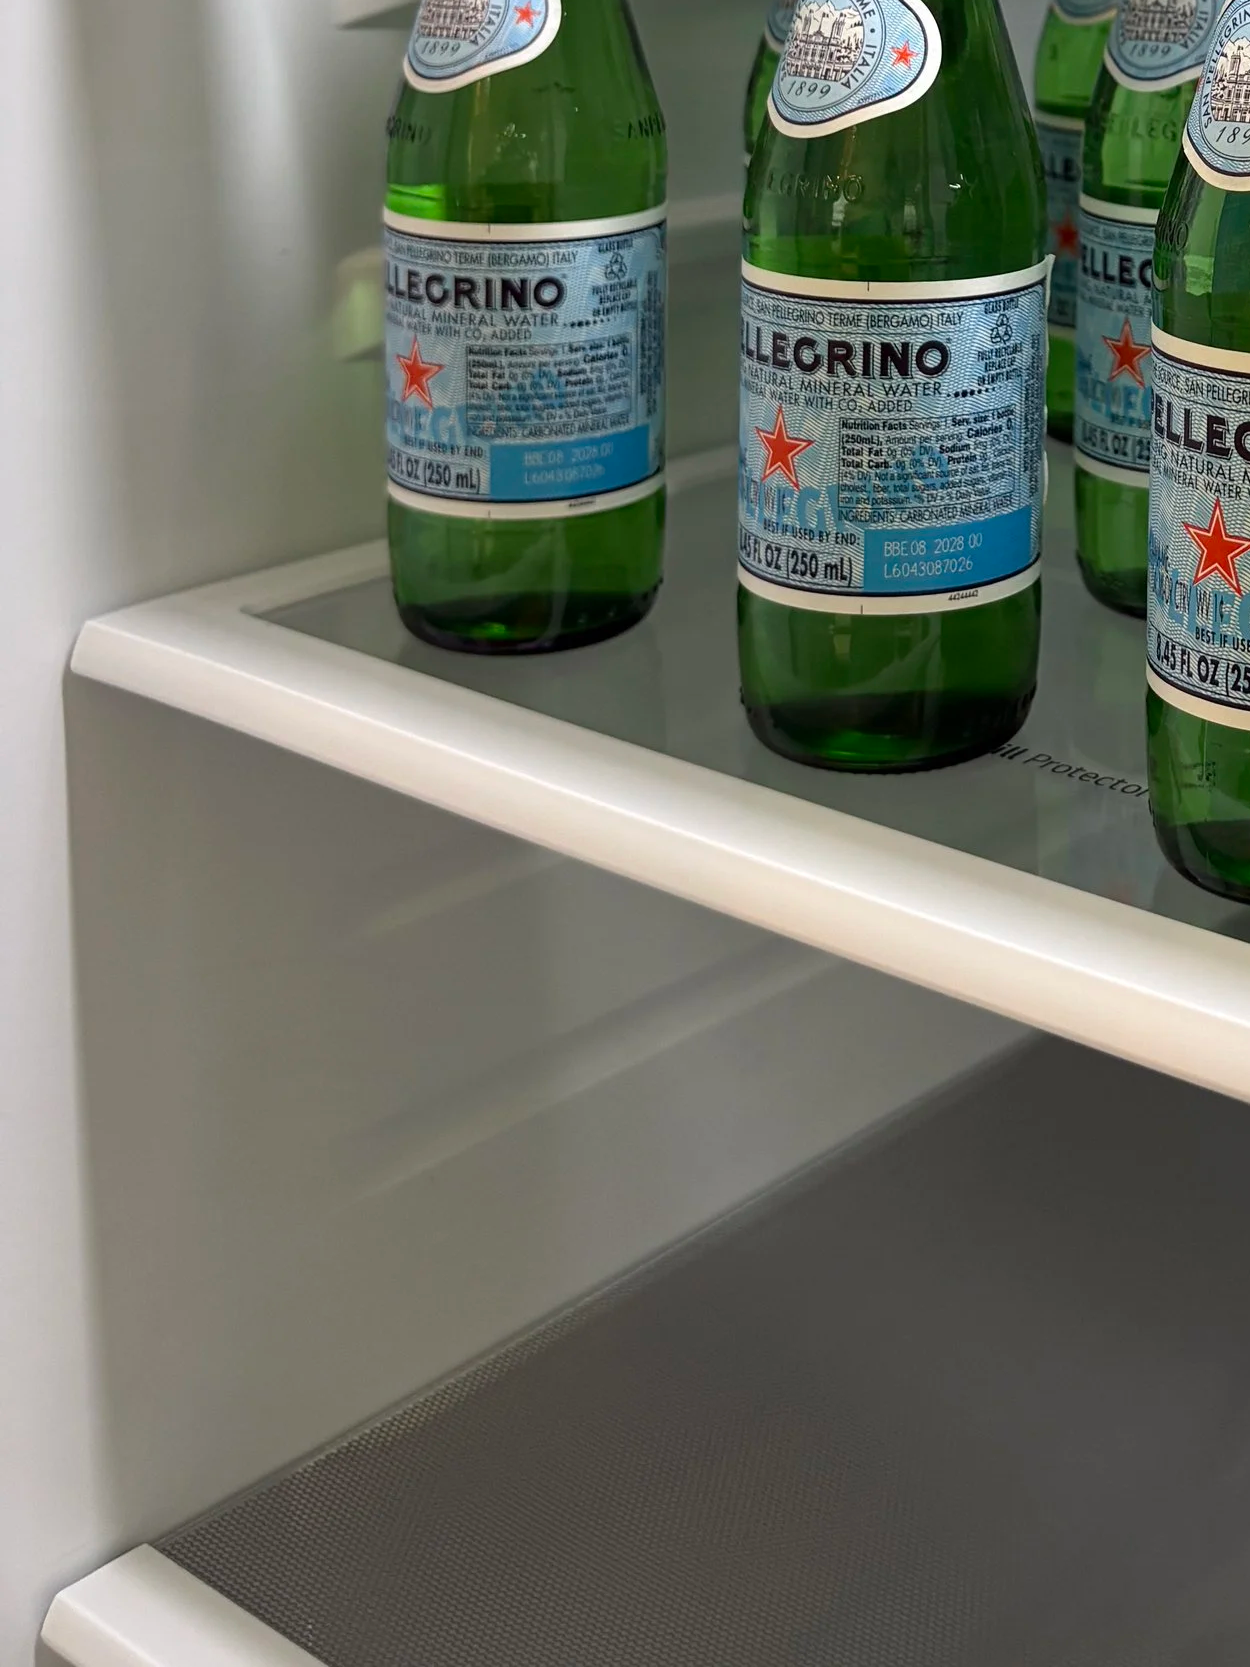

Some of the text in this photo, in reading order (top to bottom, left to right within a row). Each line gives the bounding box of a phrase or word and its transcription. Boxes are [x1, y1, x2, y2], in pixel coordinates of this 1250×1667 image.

[469, 6, 503, 47] ITALIA
[421, 40, 462, 56] 1899
[840, 44, 878, 90] ITALIA
[786, 81, 832, 99] 1899
[1201, 94, 1211, 129] SAN
[454, 250, 578, 268] TERME (BERGAMO) ITALY
[432, 311, 559, 327] MINERAL WATER
[827, 311, 862, 327] TERME
[865, 313, 934, 330] (BERGAMO)
[936, 310, 964, 326] ITALY
[491, 327, 532, 340] ADDED
[800, 380, 874, 397] MINERAL
[883, 383, 942, 396] WATER
[1185, 378, 1203, 395] SAN
[803, 393, 834, 409] WITH
[868, 399, 913, 412] ADDED
[1172, 449, 1235, 481] NATURAL
[406, 457, 480, 495] OZ (250 mL)
[1202, 478, 1242, 500] WATER
[793, 525, 816, 542] USED
[834, 530, 860, 546] END:
[934, 536, 965, 553] 2028
[968, 533, 983, 548] 00
[764, 544, 853, 587] OZ (250 mL)
[1195, 626, 1216, 644] BEST
[1220, 634, 1228, 647] IF
[1180, 649, 1193, 677] FL
[1197, 655, 1220, 686] OZ
